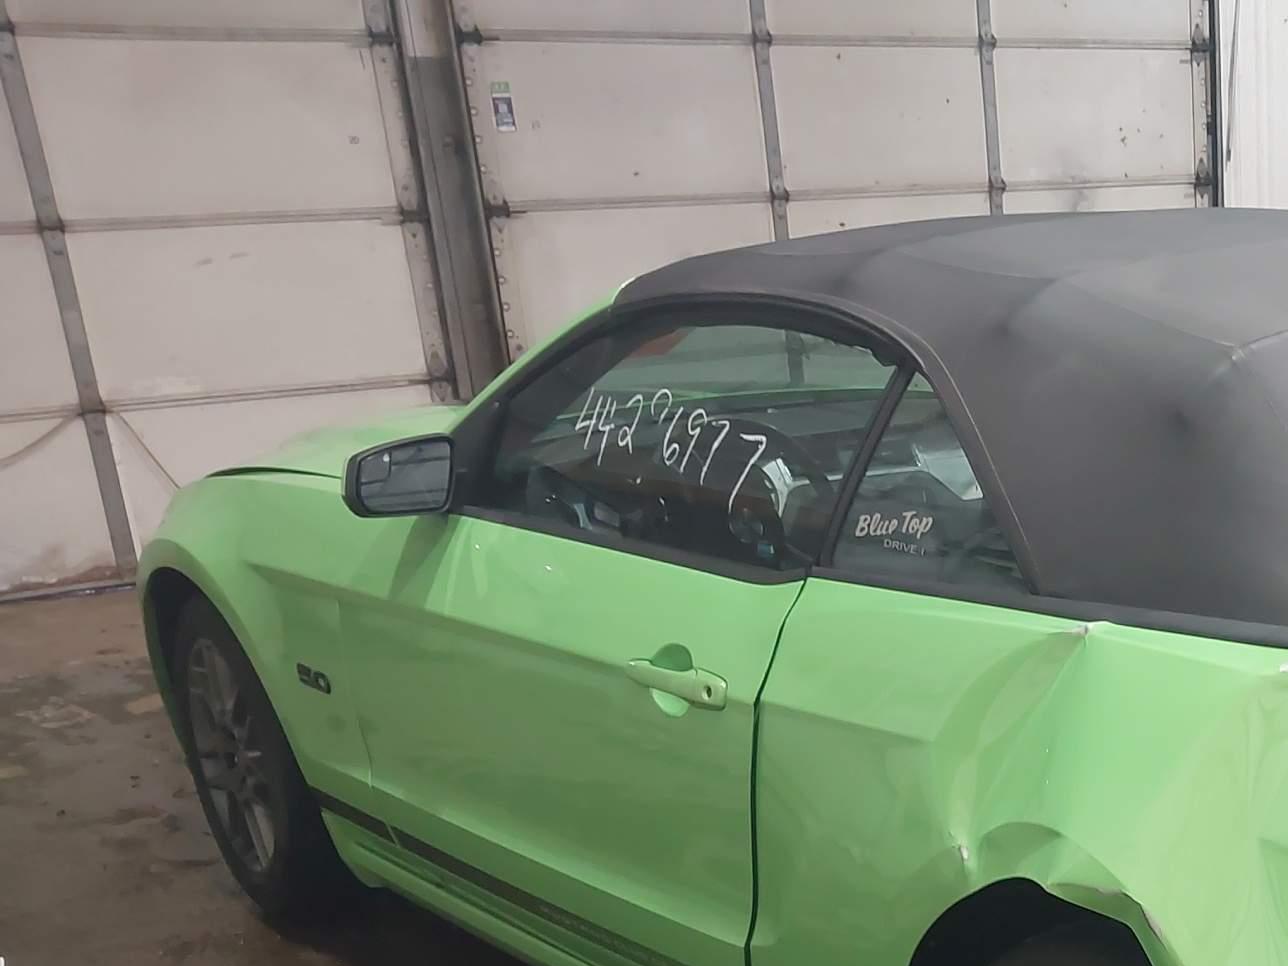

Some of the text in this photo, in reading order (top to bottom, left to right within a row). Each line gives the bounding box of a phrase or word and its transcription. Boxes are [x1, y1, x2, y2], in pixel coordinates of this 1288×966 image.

[855, 511, 933, 539] Blue Top
[883, 539, 918, 554] DRIVE
